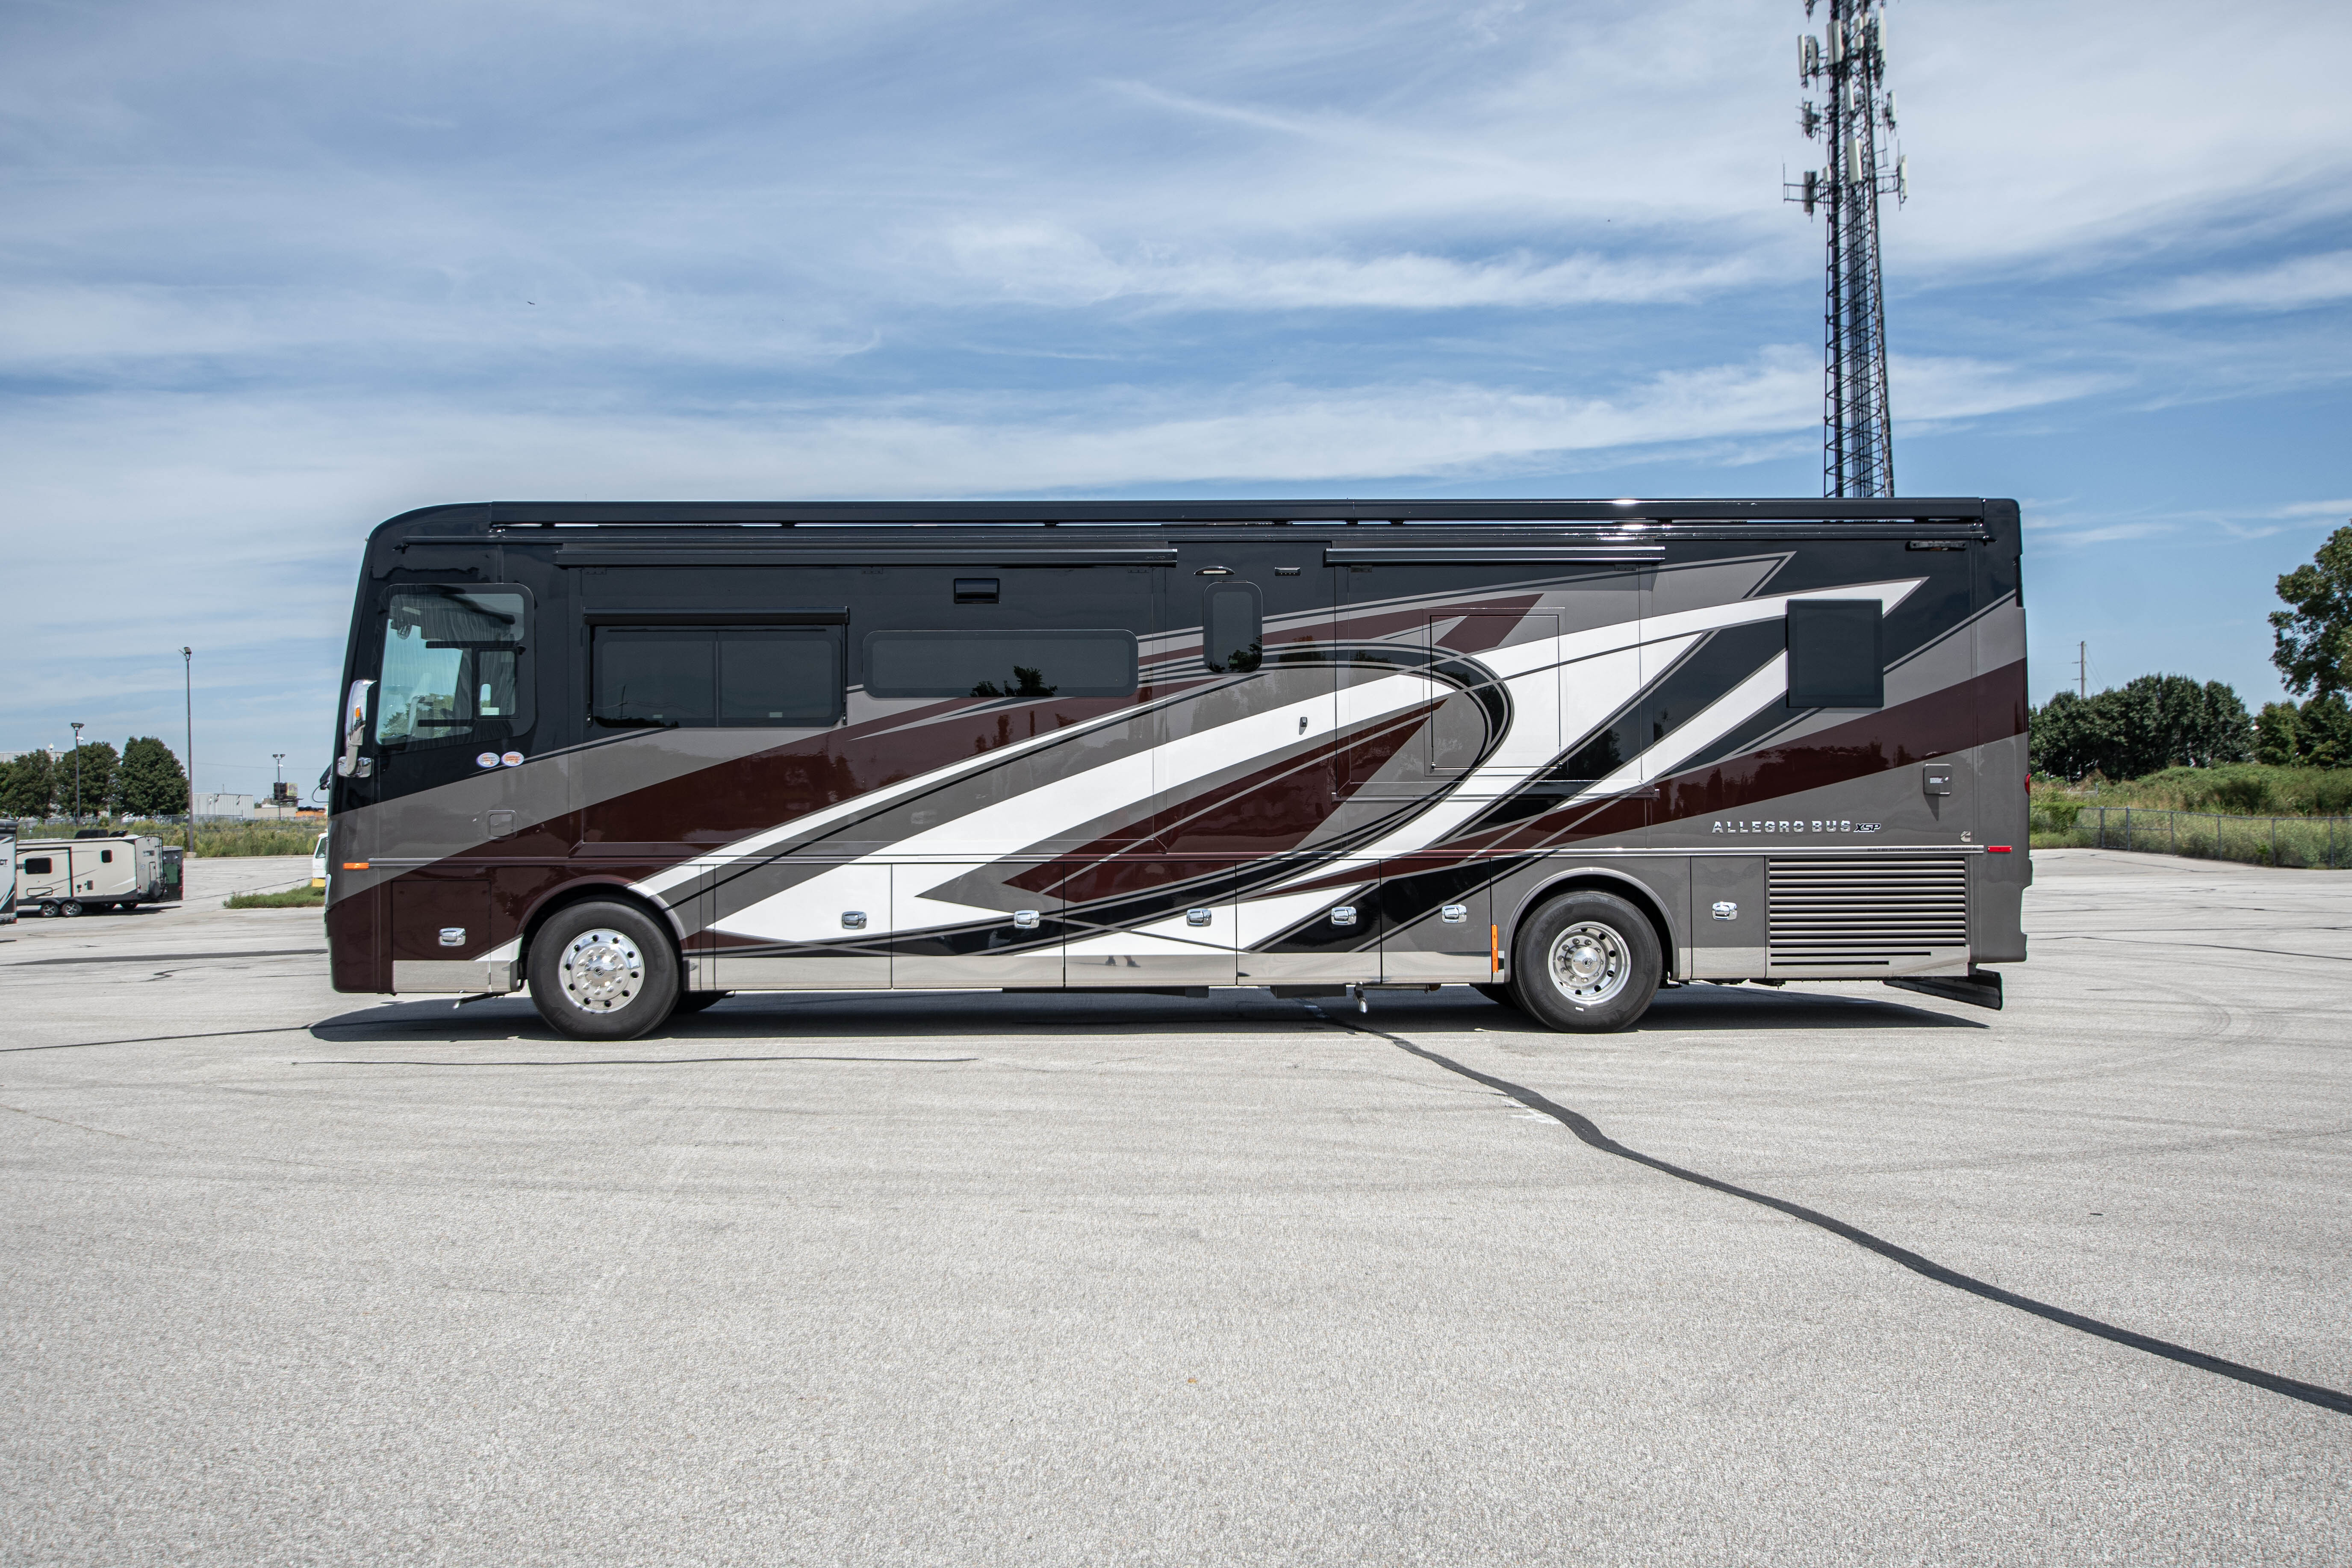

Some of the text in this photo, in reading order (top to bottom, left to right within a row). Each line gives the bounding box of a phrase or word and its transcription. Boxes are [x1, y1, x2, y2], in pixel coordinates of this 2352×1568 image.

[1712, 820, 1881, 834] ALLEGRO BUS XSP
